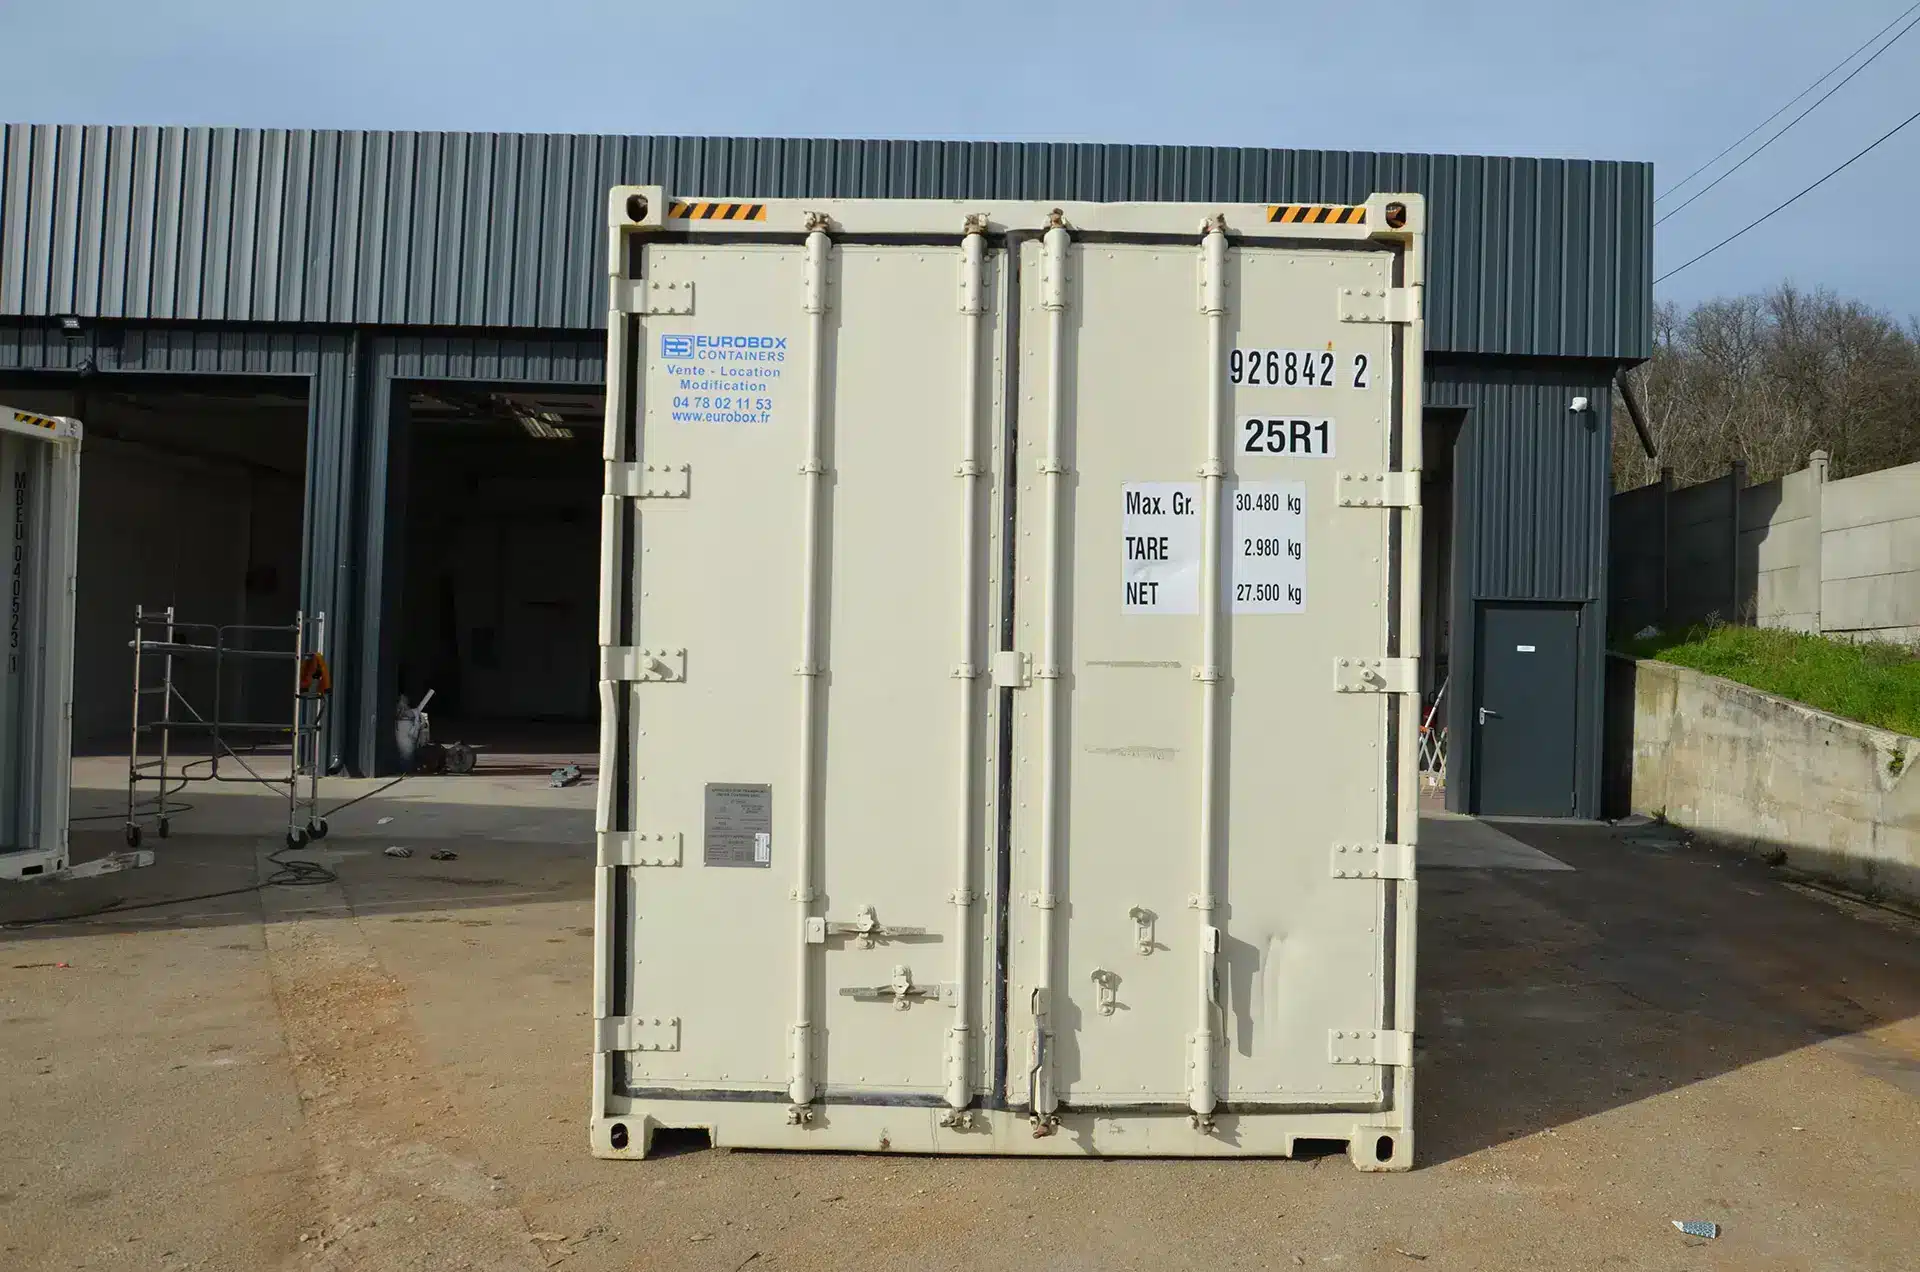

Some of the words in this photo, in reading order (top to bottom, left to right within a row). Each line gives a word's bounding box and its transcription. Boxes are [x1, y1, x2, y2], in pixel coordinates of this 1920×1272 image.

[697, 336, 787, 349] EUROBOX
[698, 350, 785, 362] CONTAINERS
[667, 364, 705, 376] Vente
[720, 366, 781, 377] Location
[1230, 350, 1334, 387] 926842
[1354, 354, 1368, 388] 2
[680, 380, 767, 391] Modification
[673, 397, 689, 408] 04
[694, 397, 710, 409] 78
[715, 398, 731, 409] 02
[736, 399, 750, 410] 11
[756, 399, 772, 410] 53
[672, 411, 771, 423] www.eurobox.fr
[1244, 419, 1329, 454] 25R1
[14, 472, 26, 540] MBEU
[1126, 491, 1166, 516] Max.
[1172, 491, 1195, 516] Gr.
[1236, 493, 1279, 512] 30.480
[1287, 493, 1302, 515] kg
[1126, 536, 1169, 560] TARE
[1244, 538, 1280, 557] 2.980
[1287, 538, 1302, 560] kg
[11, 545, 22, 648] 040523
[1126, 582, 1159, 605] NET
[1236, 584, 1280, 602] 27.500
[1287, 584, 1302, 605] kg
